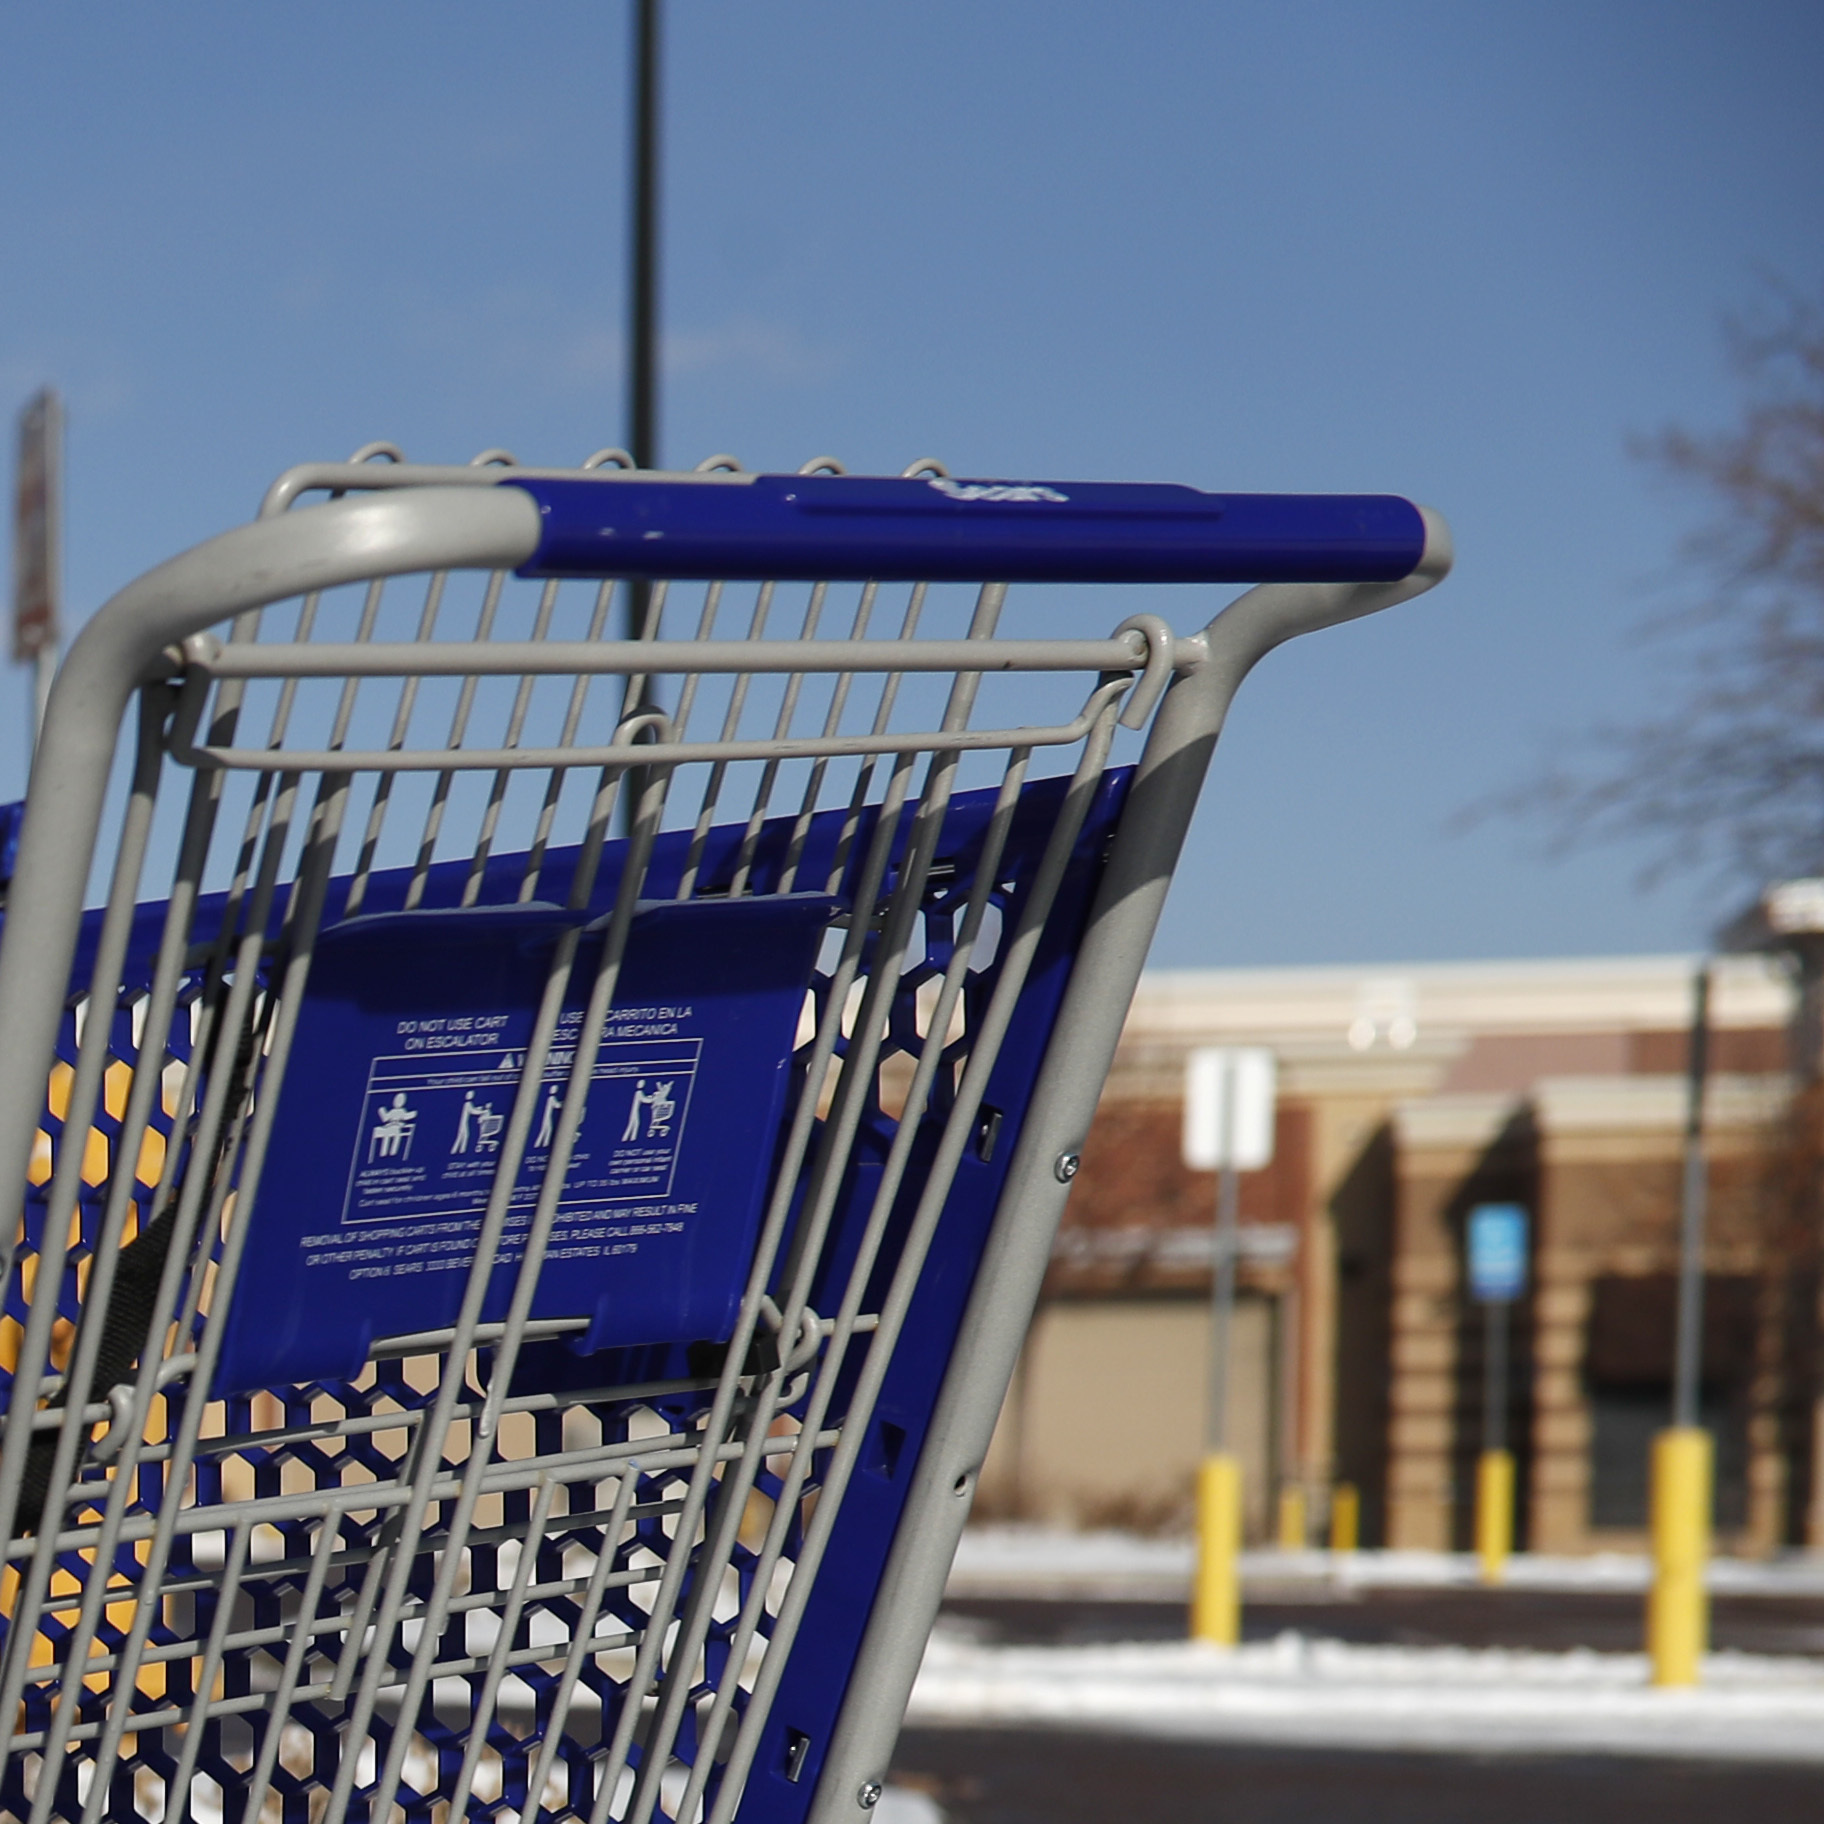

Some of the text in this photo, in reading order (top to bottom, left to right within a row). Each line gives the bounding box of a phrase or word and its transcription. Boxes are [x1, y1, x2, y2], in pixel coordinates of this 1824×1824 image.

[657, 1007, 677, 1019] EN
[676, 1006, 692, 1018] LA
[396, 1015, 509, 1034] DO NOT USE CART
[404, 1032, 500, 1050] ON ESCALATOR
[299, 1233, 343, 1249] REMOVAL
[343, 1231, 359, 1244] OF
[358, 1227, 406, 1242] SHOPPING
[406, 1223, 437, 1237] CARTS
[436, 1221, 464, 1234] FROM
[463, 1219, 483, 1231] THE
[593, 1208, 612, 1221] AND
[632, 1204, 668, 1217] RESULT
[667, 1204, 678, 1215] IN
[677, 1202, 699, 1214] FINE
[305, 1254, 322, 1267] OR
[321, 1251, 355, 1265] OTHER
[405, 1242, 432, 1256] CART
[439, 1238, 472, 1252] FOUND
[570, 1226, 607, 1240] PLEASE
